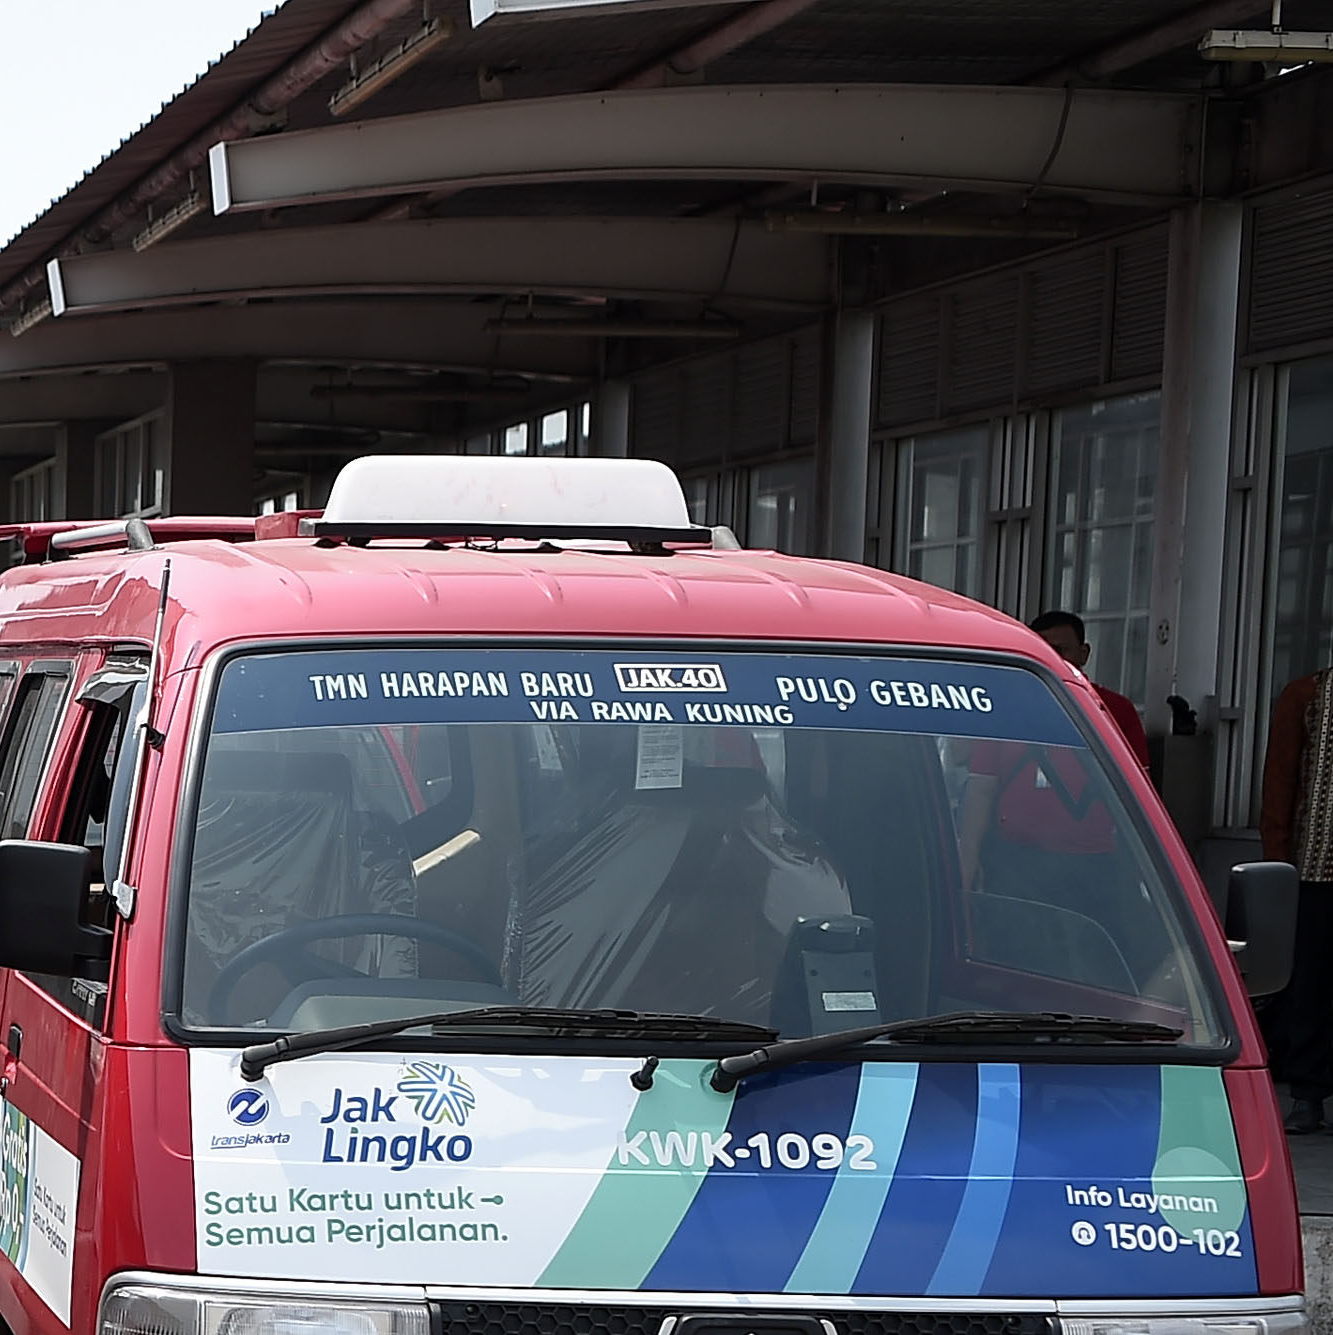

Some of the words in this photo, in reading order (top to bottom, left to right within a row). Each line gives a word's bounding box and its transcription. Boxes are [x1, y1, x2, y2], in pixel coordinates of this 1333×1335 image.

[309, 674, 368, 700] TMN
[380, 672, 509, 698] HARAPAN
[520, 672, 594, 698] BARU
[626, 668, 719, 689] JAK.40
[776, 677, 857, 705] PULO
[871, 679, 993, 713] GEBANG
[529, 701, 579, 720] VIA
[591, 701, 673, 722] RAWA
[686, 703, 794, 725] KUNING
[320, 1087, 399, 1124] Jak
[210, 1132, 291, 1149] transjakarta
[322, 1127, 473, 1172] Lingko
[617, 1131, 877, 1170] KWK-1092
[204, 1191, 277, 1215] Satu
[289, 1188, 373, 1212] Kartu
[384, 1186, 474, 1210] untuk
[1065, 1185, 1113, 1207] Info
[1118, 1187, 1218, 1214] Layanan
[205, 1222, 315, 1246] Semua
[327, 1217, 509, 1249] Perjalanan.
[1104, 1223, 1242, 1258] 1500-102
